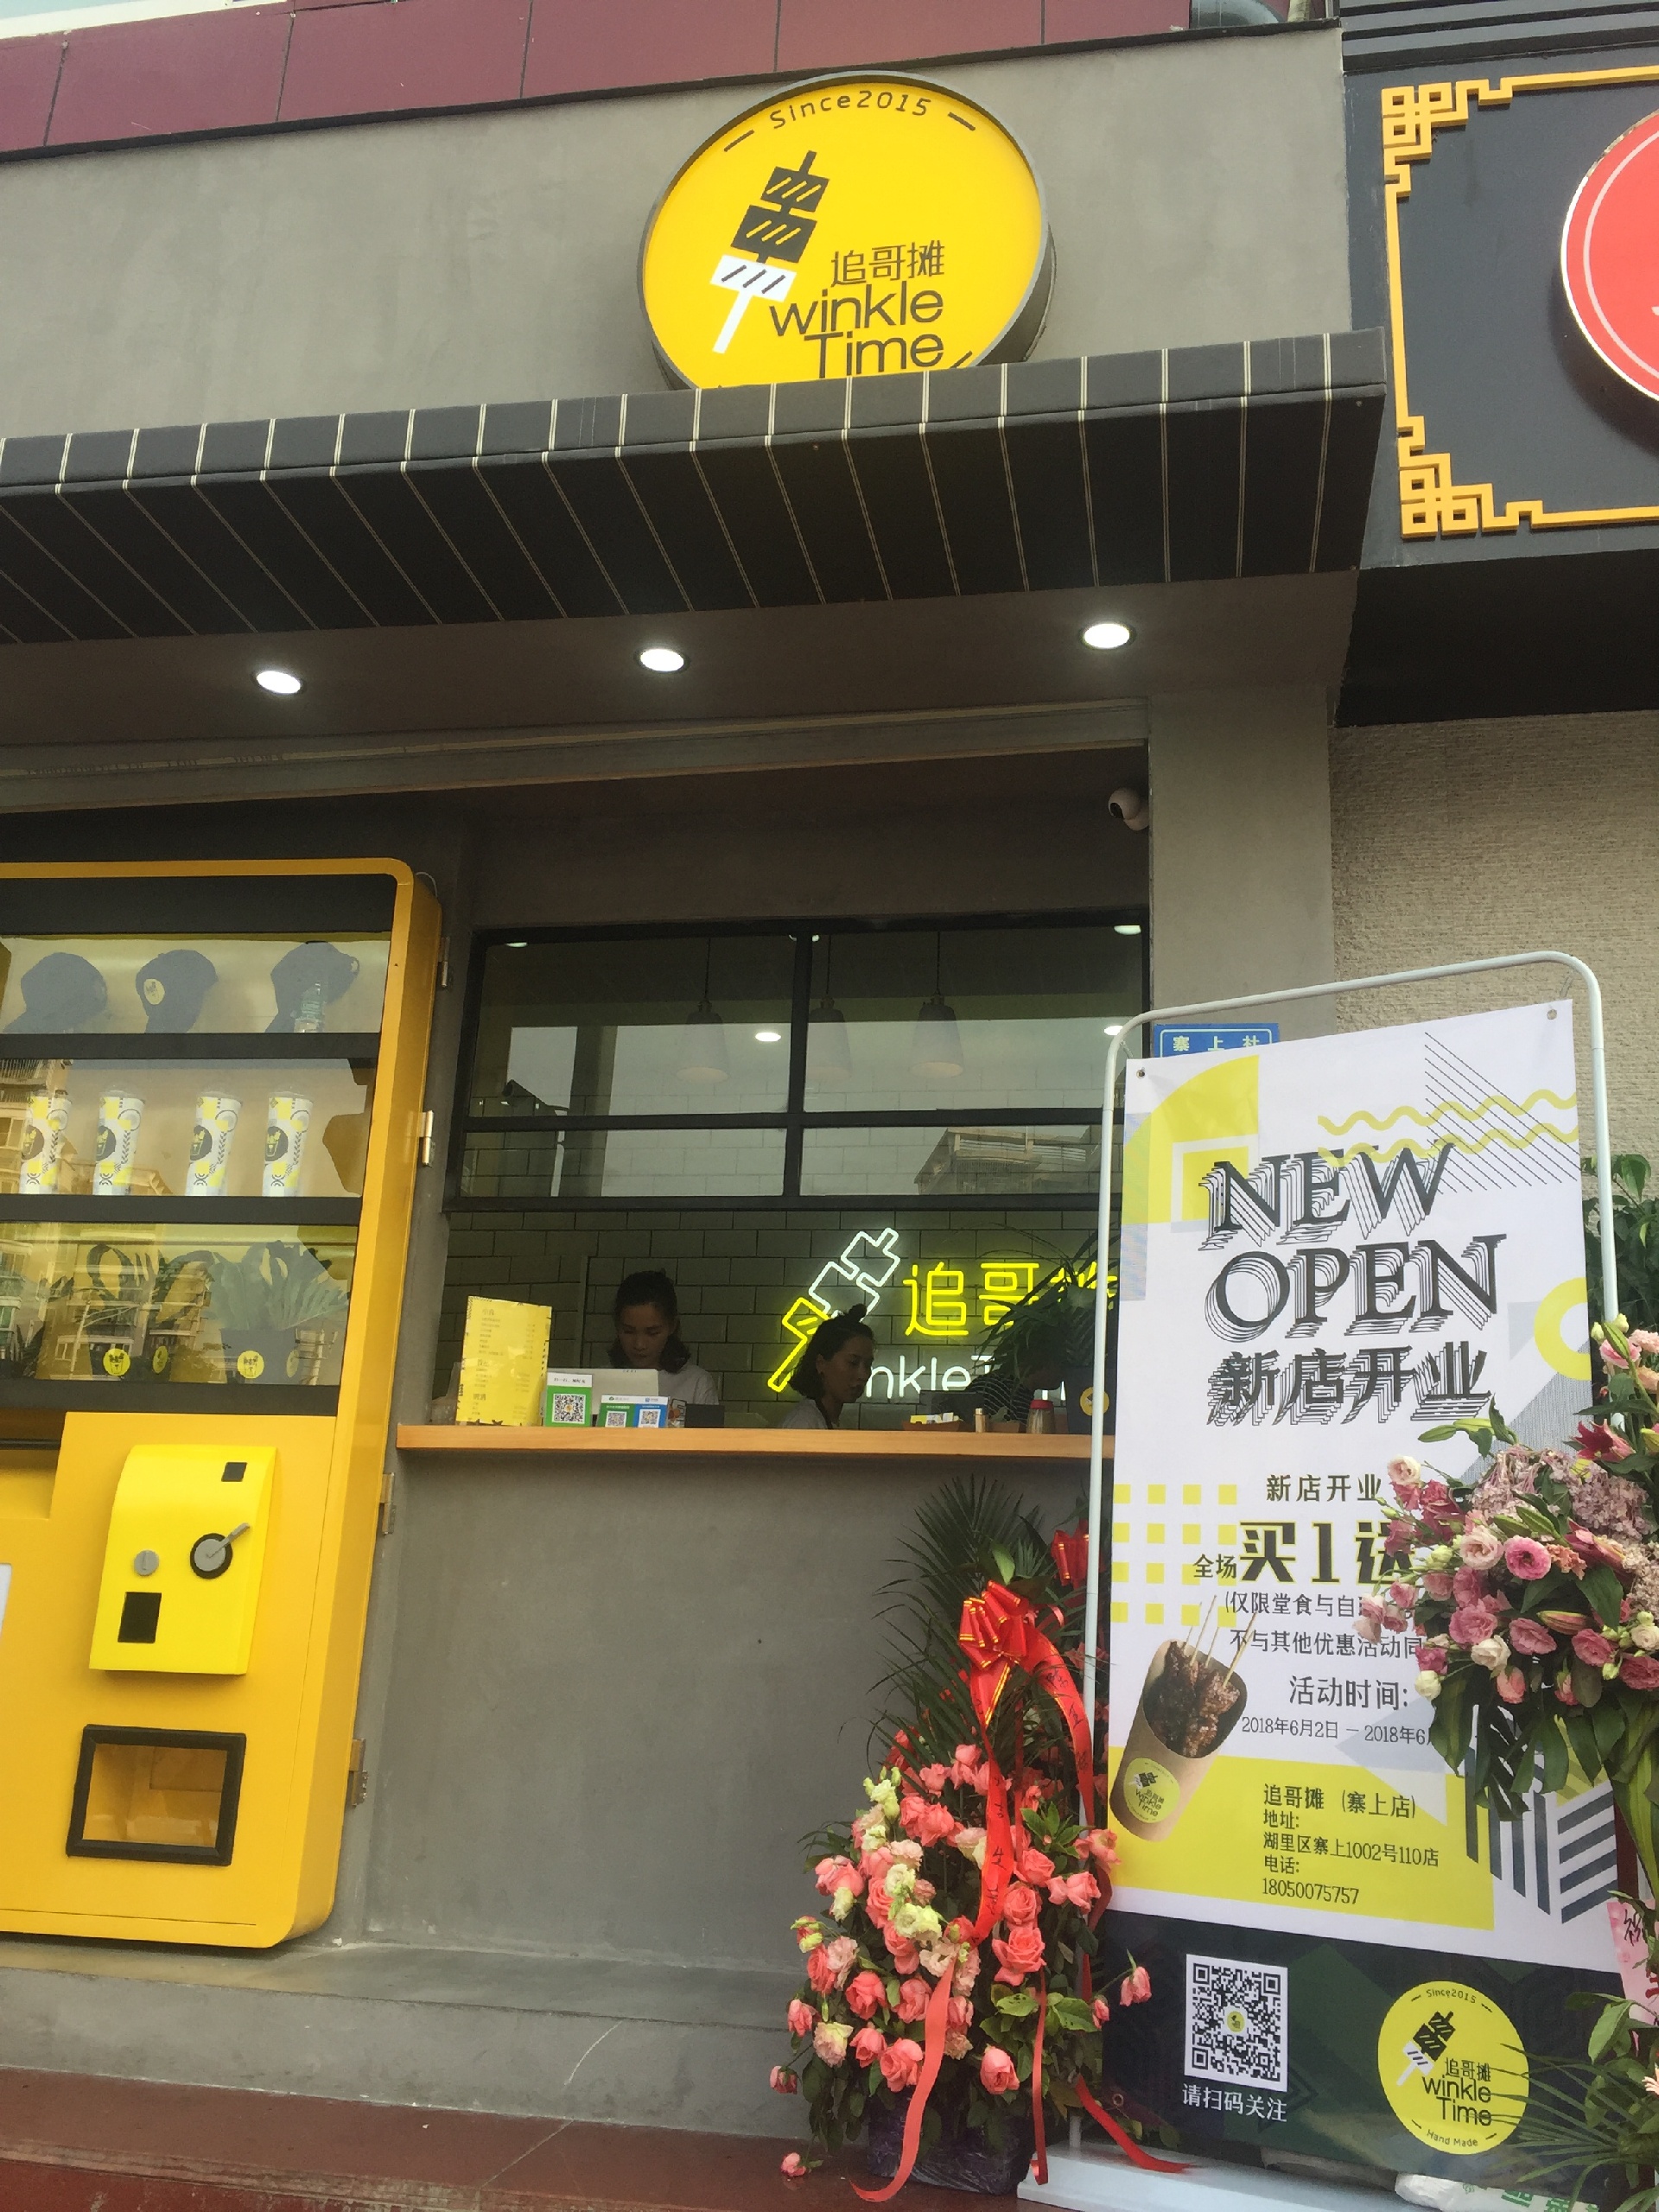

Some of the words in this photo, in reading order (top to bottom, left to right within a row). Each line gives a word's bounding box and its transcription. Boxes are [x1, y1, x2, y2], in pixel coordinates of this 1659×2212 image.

[769, 90, 932, 130] Since2015
[830, 239, 945, 288] 追哥摊
[804, 332, 944, 378] Time
[1198, 1138, 1456, 1251] NEW
[1205, 1233, 1507, 1343] OPEN
[1206, 1340, 1492, 1427] 新店开业
[1266, 1473, 1382, 1502] 新店开业
[1225, 1592, 1363, 1618] （仅限堂食与自
[1363, 1725, 1431, 1746] 2018年6
[1262, 1831, 1439, 1867] 湖里区寨上1002号110店
[1262, 1878, 1359, 1905] 18050075757
[1444, 2057, 1491, 2082] 追哥摊
[1182, 2083, 1287, 2122] 请扫码关注
[1435, 2096, 1492, 2126] Time
[1427, 2130, 1451, 2145] Hand
[1453, 2138, 1478, 2147] Made
